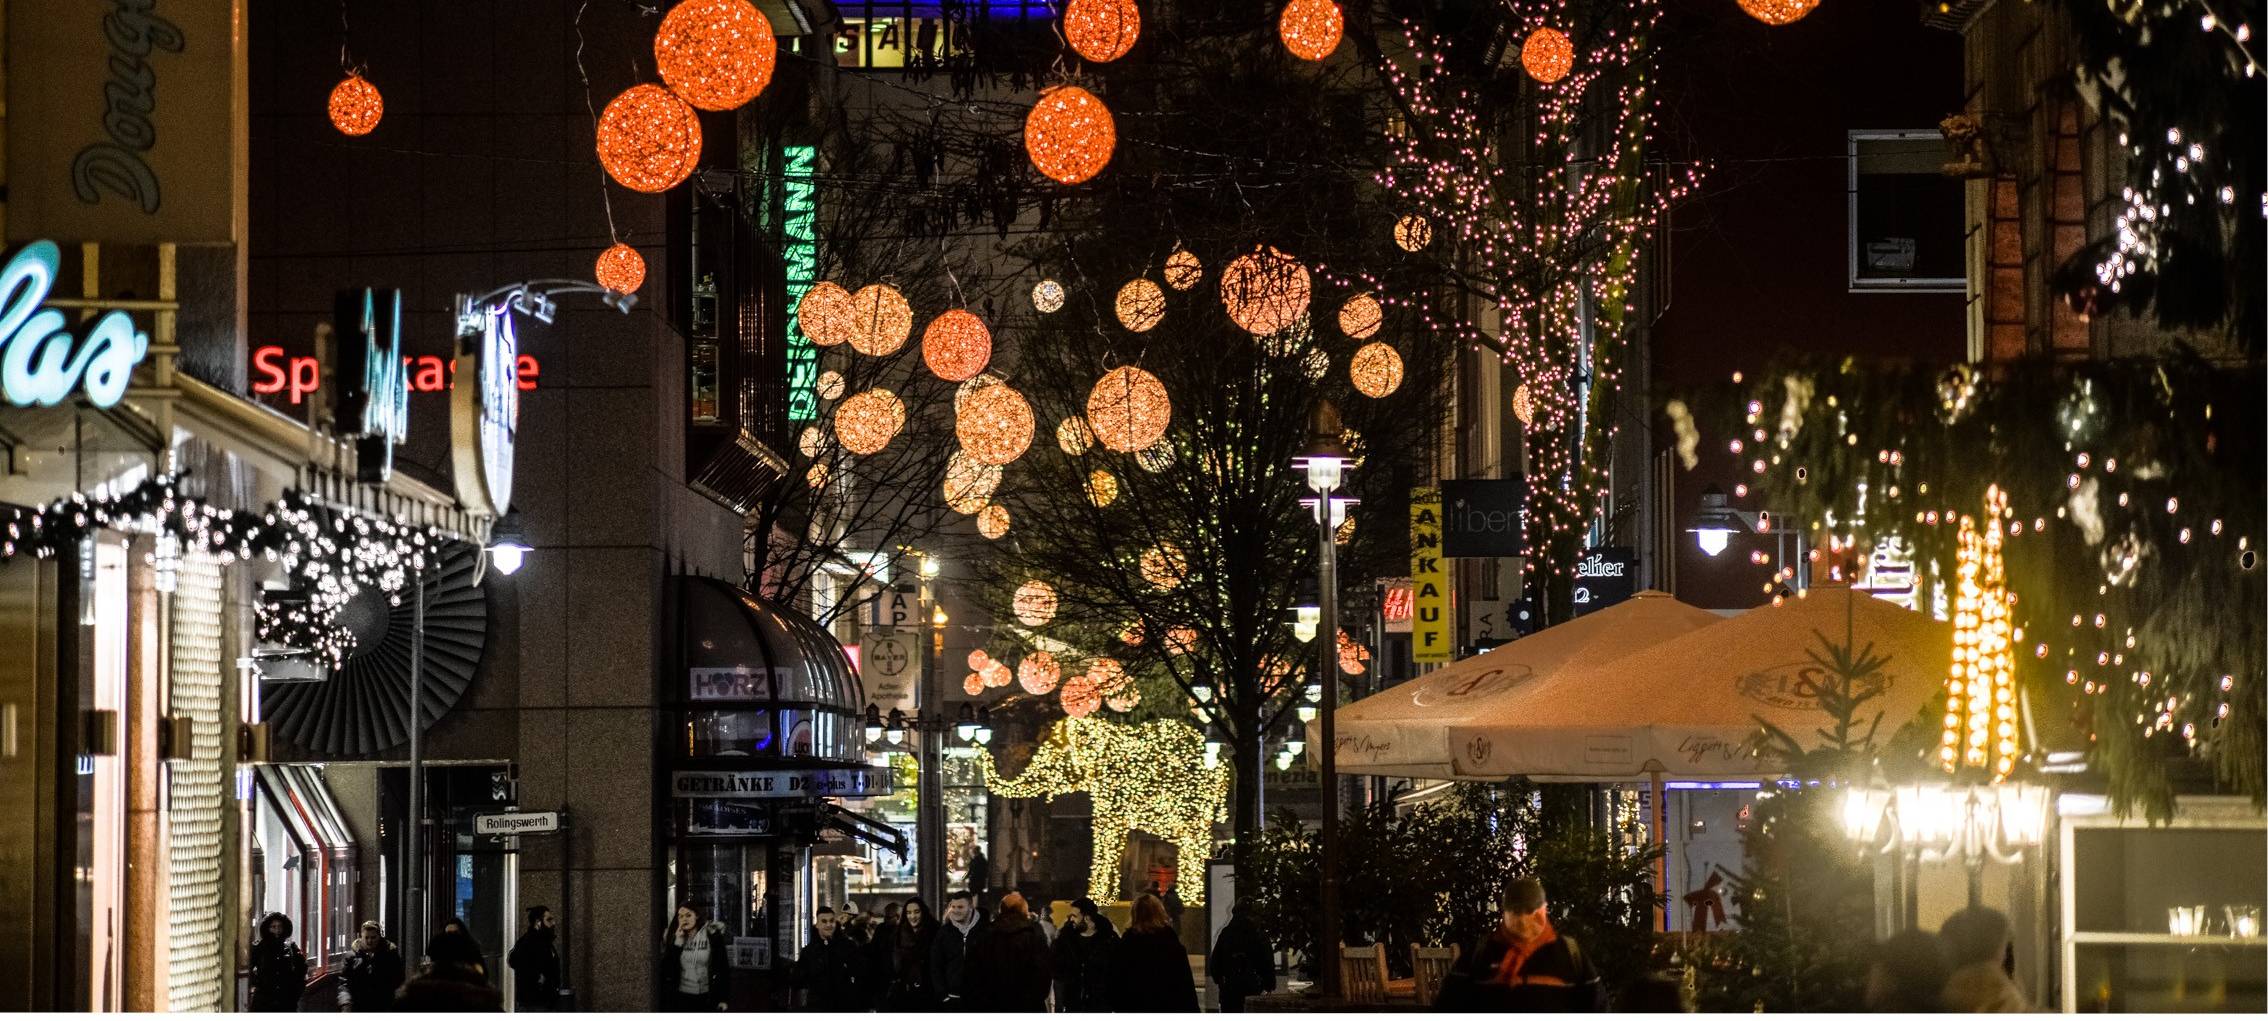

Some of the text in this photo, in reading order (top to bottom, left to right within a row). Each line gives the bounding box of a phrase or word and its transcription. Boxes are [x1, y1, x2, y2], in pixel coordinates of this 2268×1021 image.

[1416, 508, 1440, 647] ANKAUF
[891, 594, 907, 632] AP
[677, 774, 774, 792] GETRÄNKE
[789, 776, 809, 791] D2
[486, 816, 548, 830] Rolingswerth
